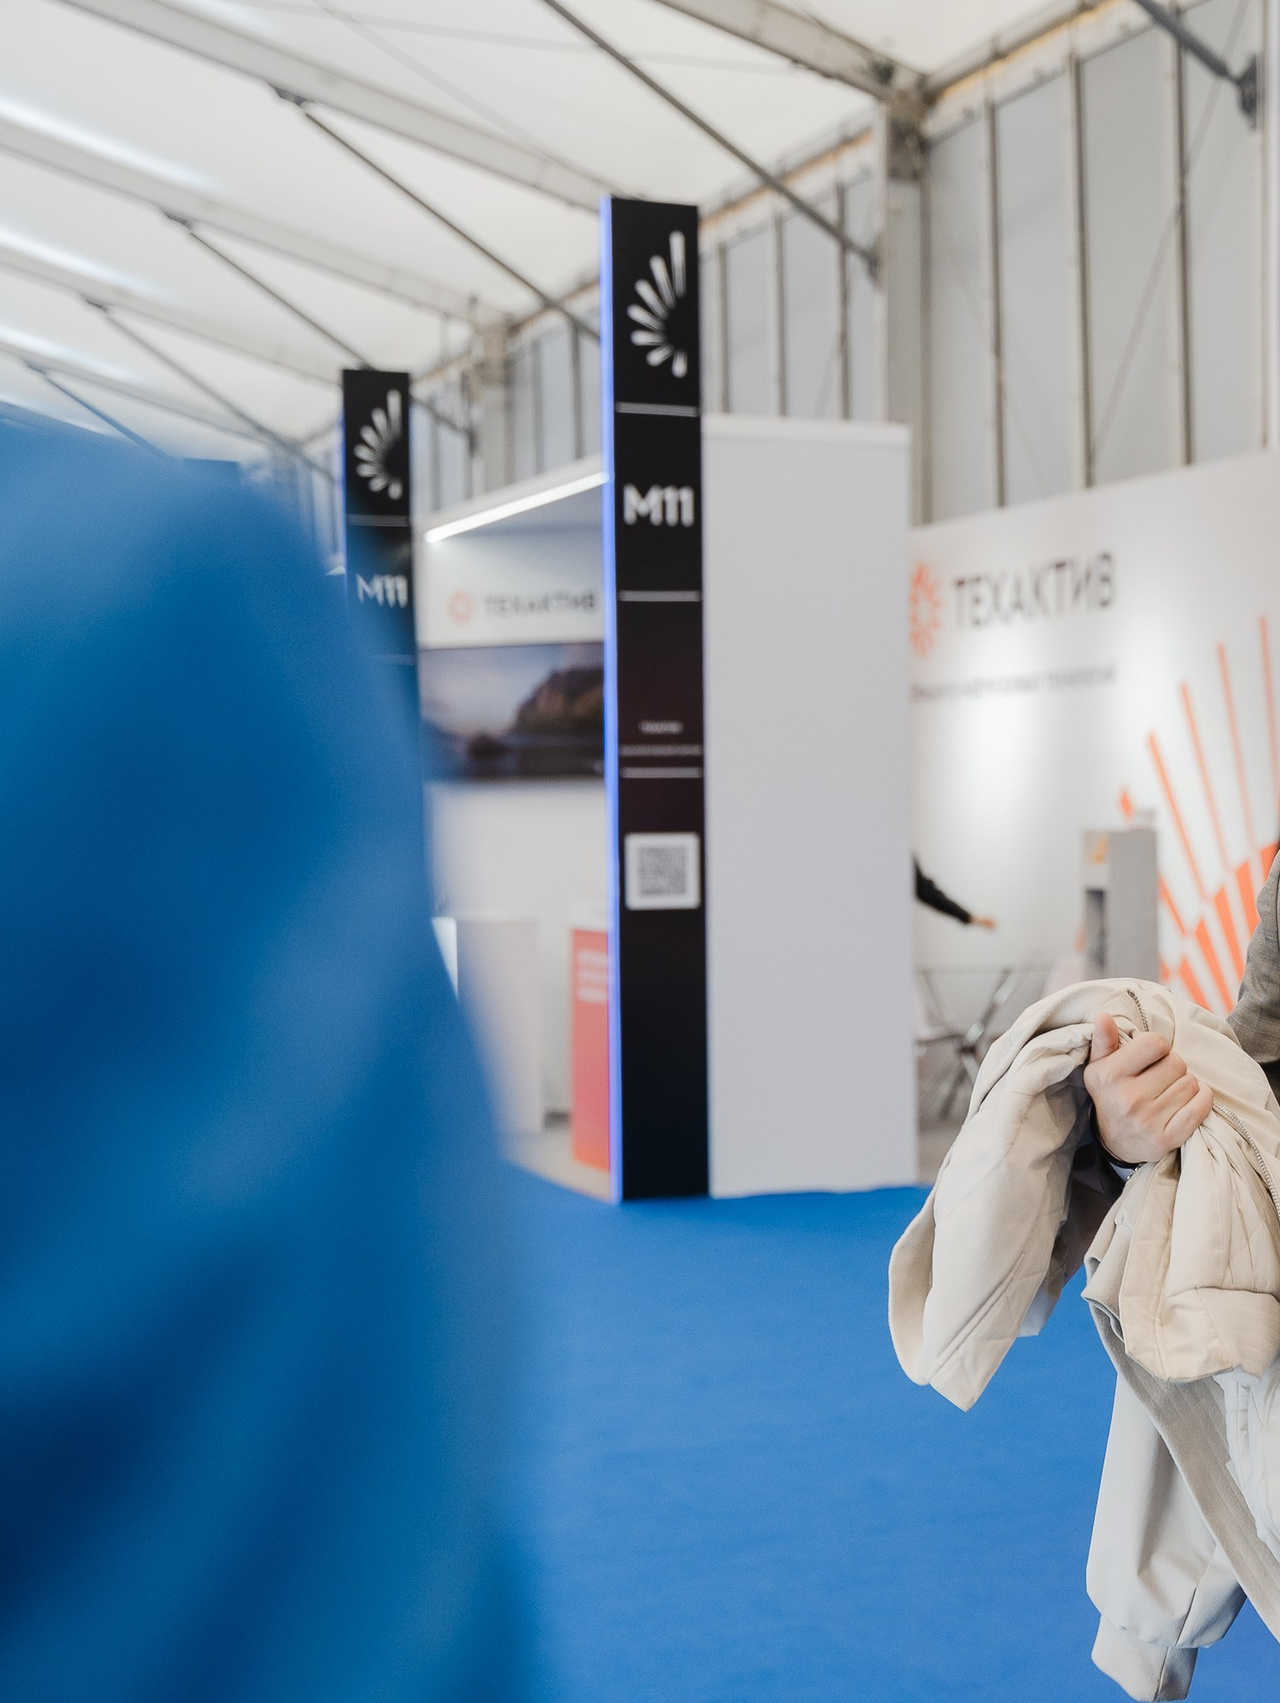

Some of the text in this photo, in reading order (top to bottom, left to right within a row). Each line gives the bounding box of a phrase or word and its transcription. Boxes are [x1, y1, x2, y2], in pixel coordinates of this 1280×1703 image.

[623, 483, 695, 528] M11
[356, 573, 408, 608] M11
[953, 550, 1113, 631] ТЕХАКТИВ
